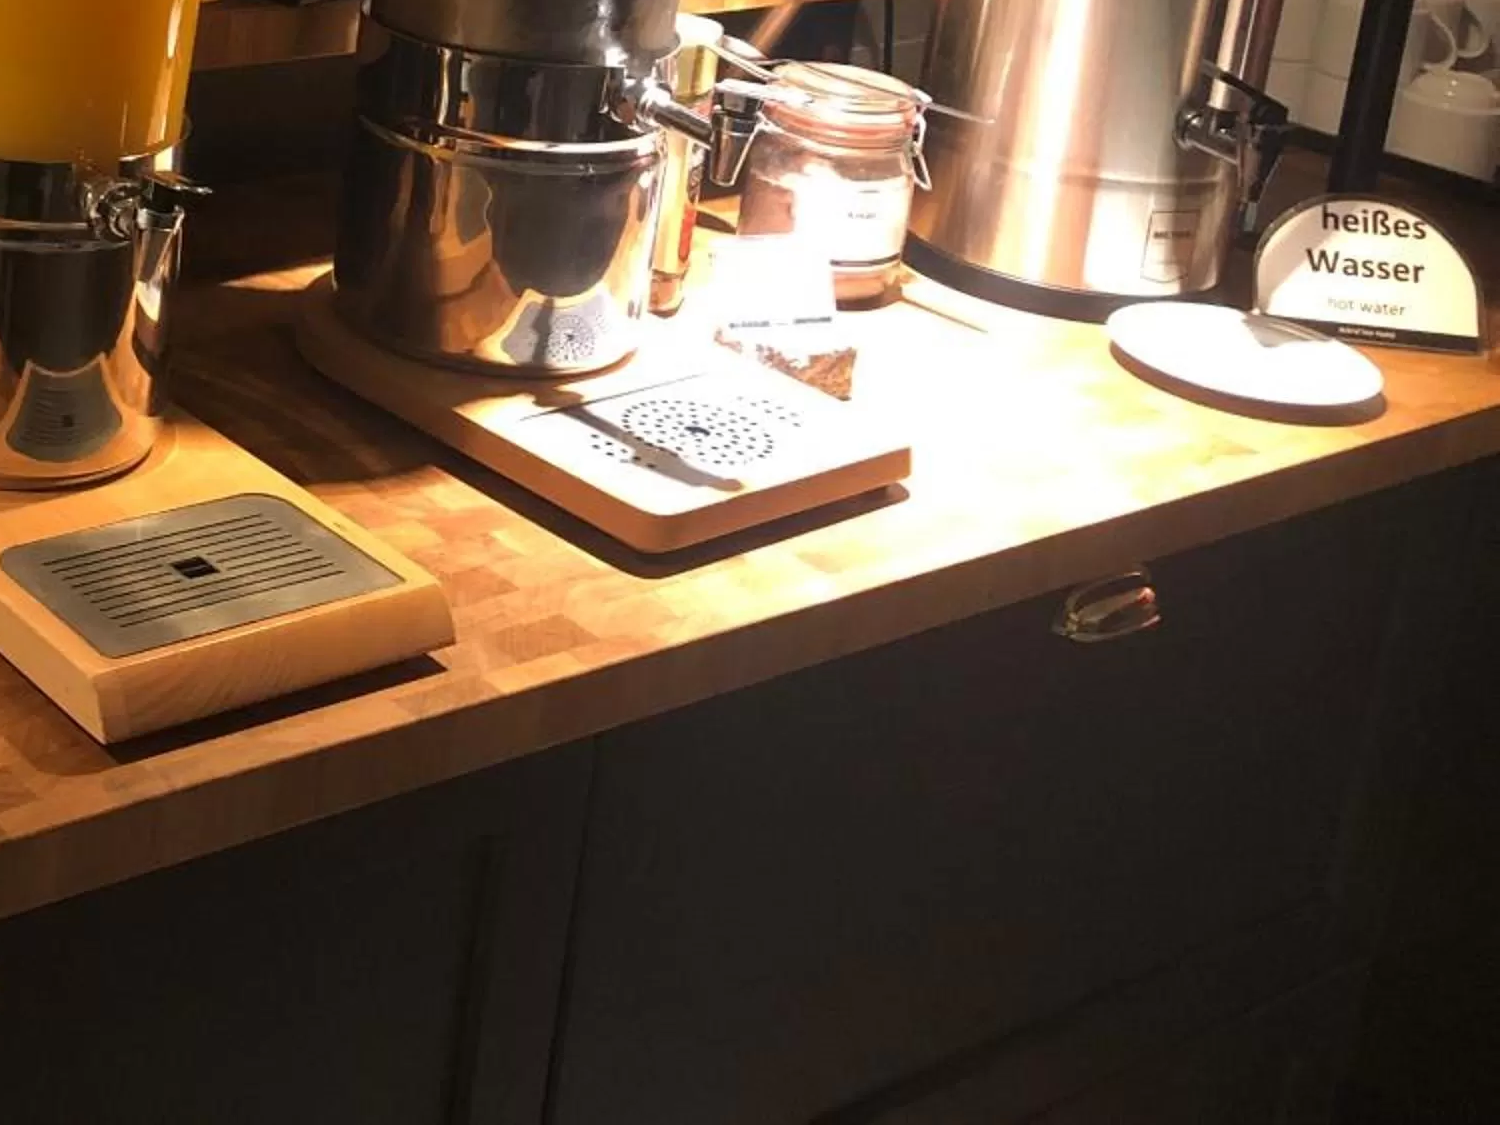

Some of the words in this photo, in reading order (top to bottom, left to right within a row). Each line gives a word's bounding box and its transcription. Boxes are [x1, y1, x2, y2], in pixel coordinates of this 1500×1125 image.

[1322, 205, 1427, 240] heißes
[1306, 247, 1425, 284] Wasser
[1327, 297, 1355, 311] hot
[1360, 300, 1407, 316] water
